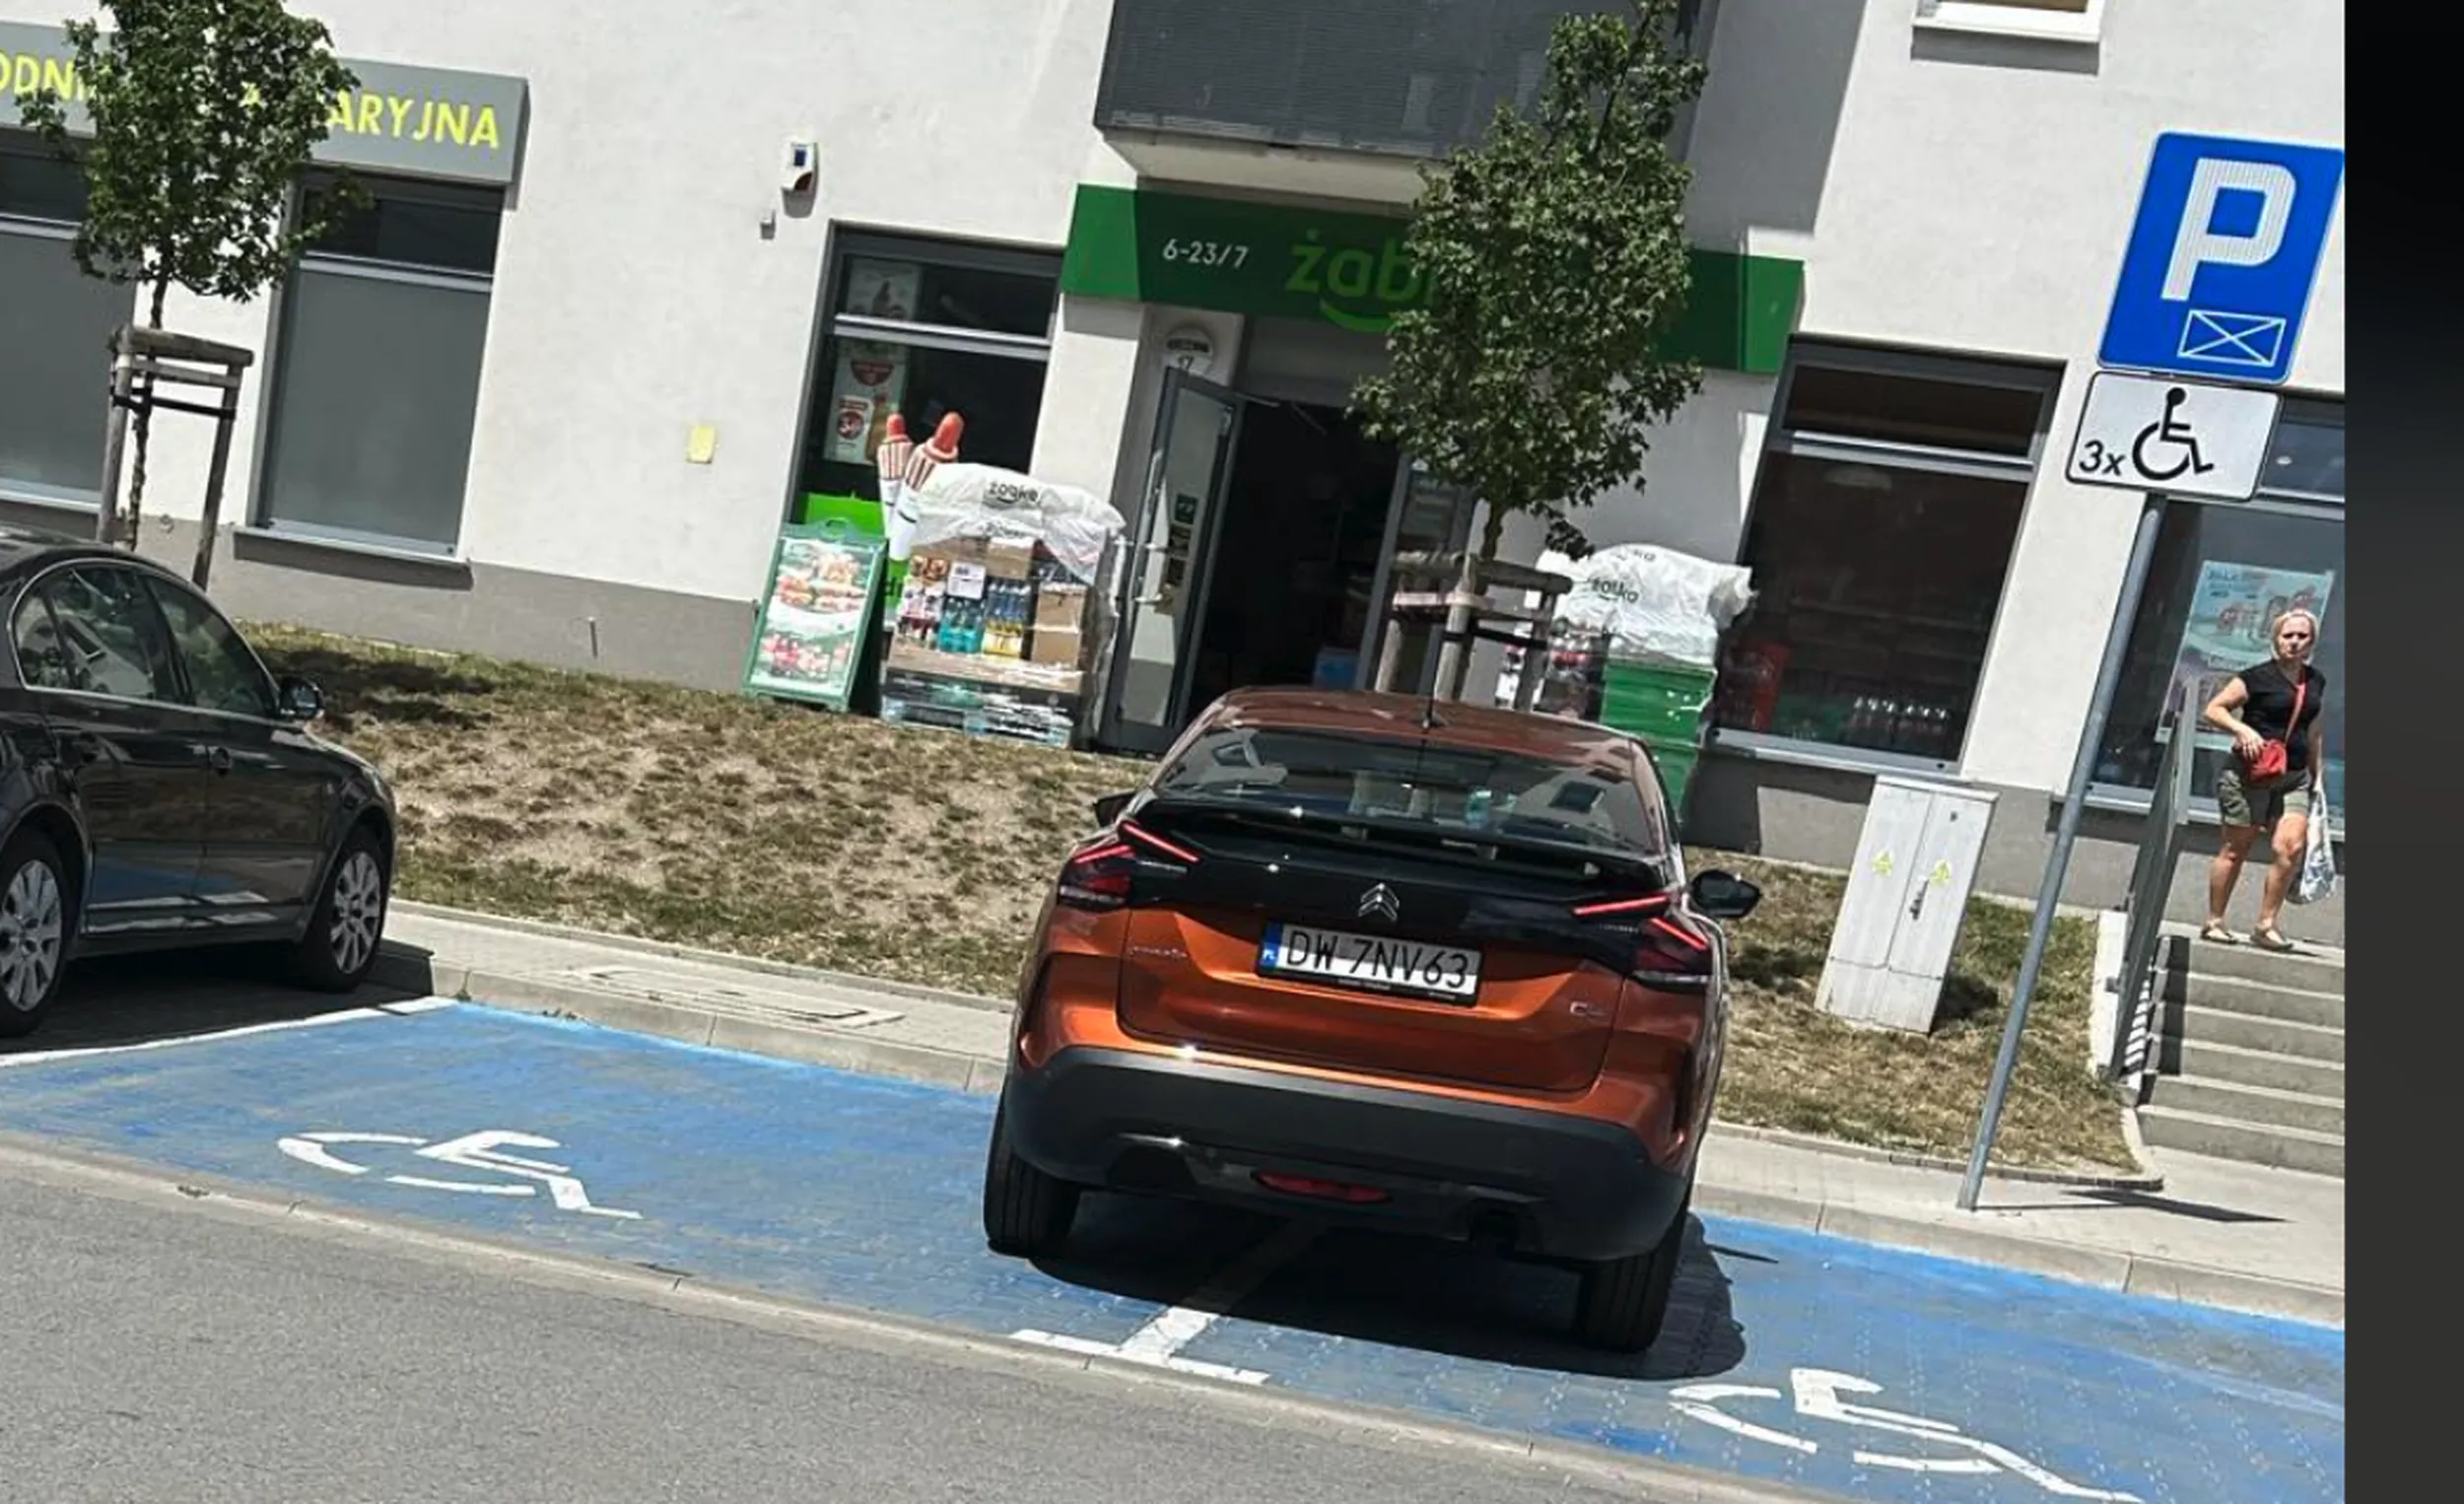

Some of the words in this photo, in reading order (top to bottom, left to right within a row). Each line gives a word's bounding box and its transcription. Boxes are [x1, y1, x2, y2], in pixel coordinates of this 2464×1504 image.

[1162, 238, 1250, 269] 6-23/7
[2160, 157, 2297, 302] P
[1285, 228, 1435, 305] żab
[2078, 439, 2126, 477] 3x
[1287, 930, 1338, 971] DW
[1348, 937, 1470, 990] 7NV63
